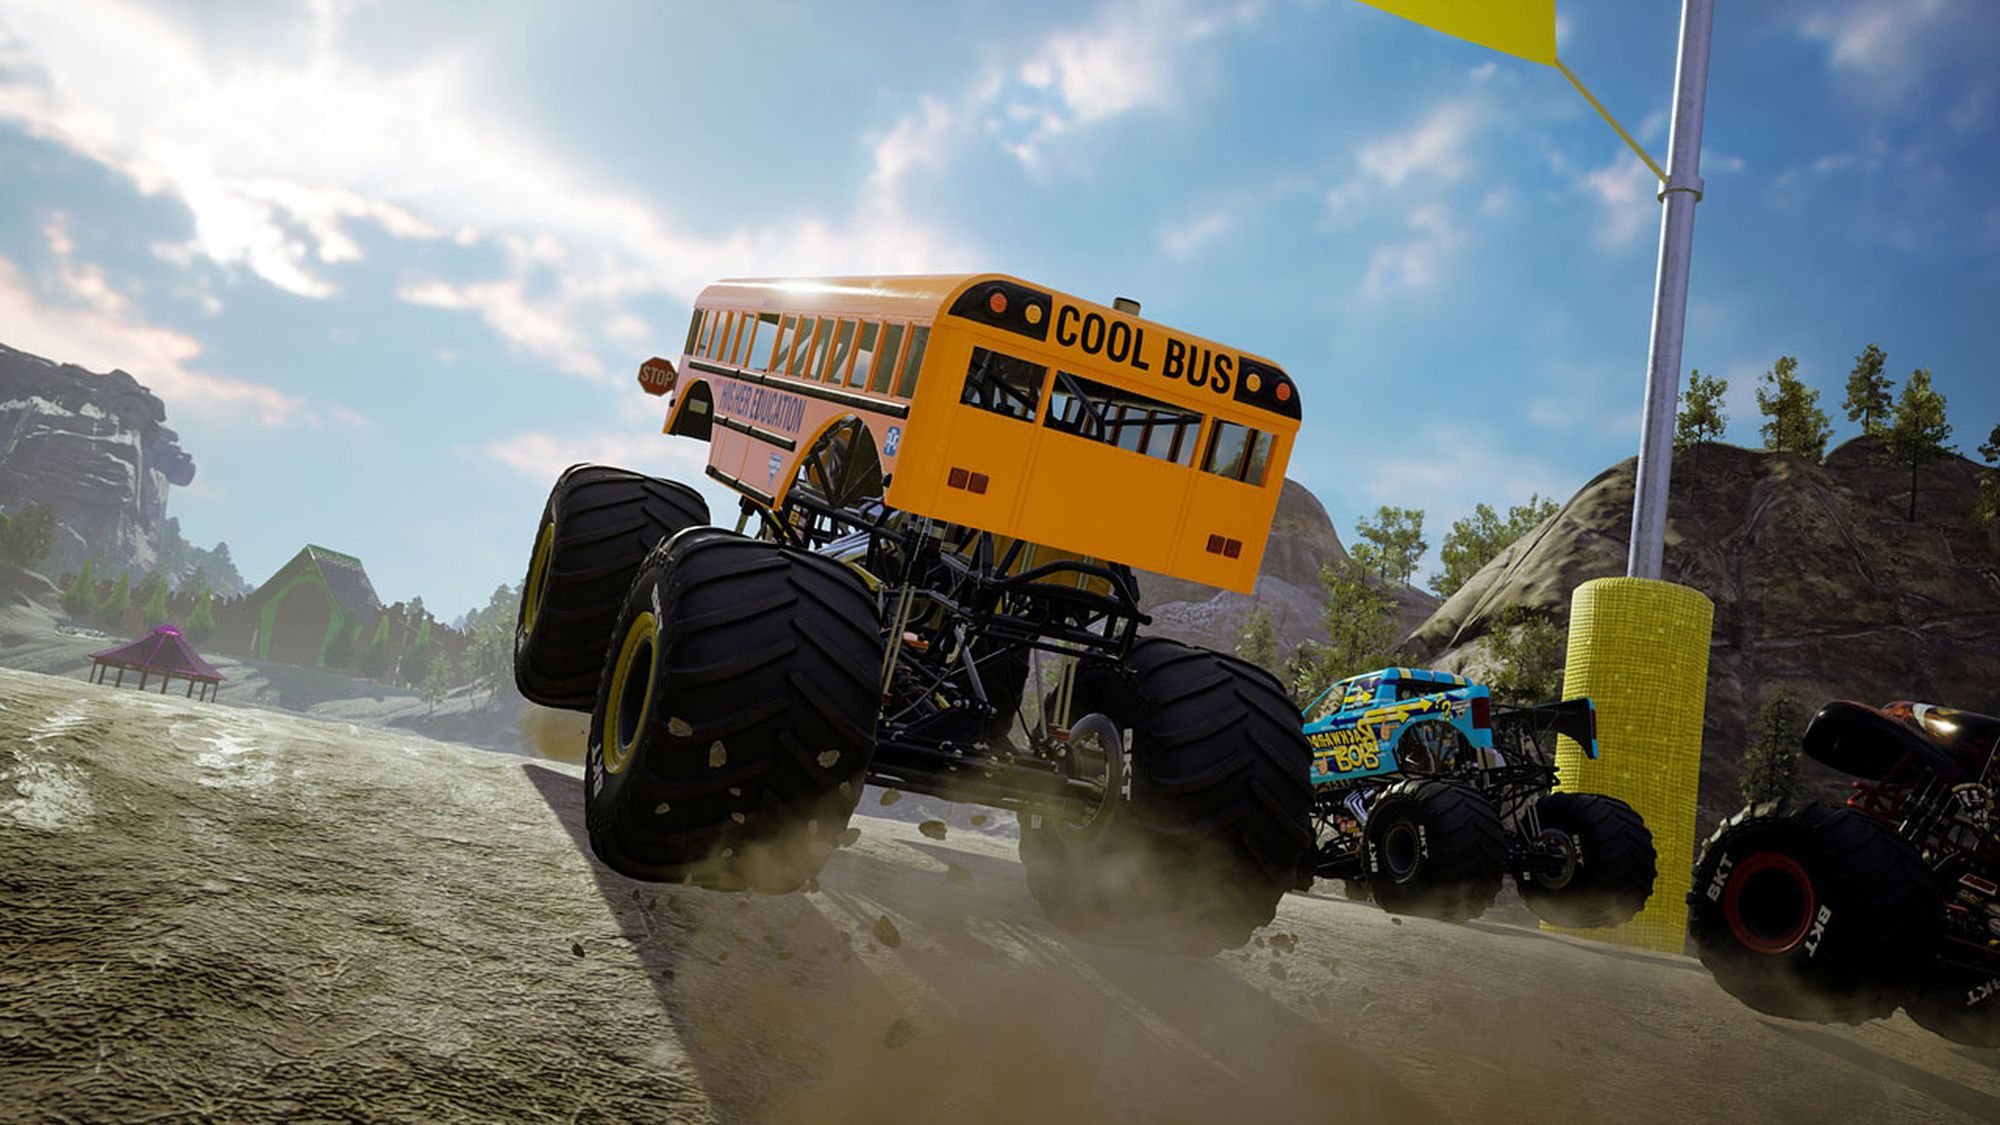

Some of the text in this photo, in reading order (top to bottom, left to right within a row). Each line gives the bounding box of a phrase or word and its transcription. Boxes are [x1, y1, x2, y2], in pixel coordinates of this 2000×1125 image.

[1056, 304, 1233, 394] COOL BUS
[640, 365, 675, 385] STOP
[749, 388, 806, 434] EDUCATION
[1368, 840, 1379, 873] BKT
[1706, 852, 1733, 901] BKT
[1804, 904, 1832, 958] BKT
